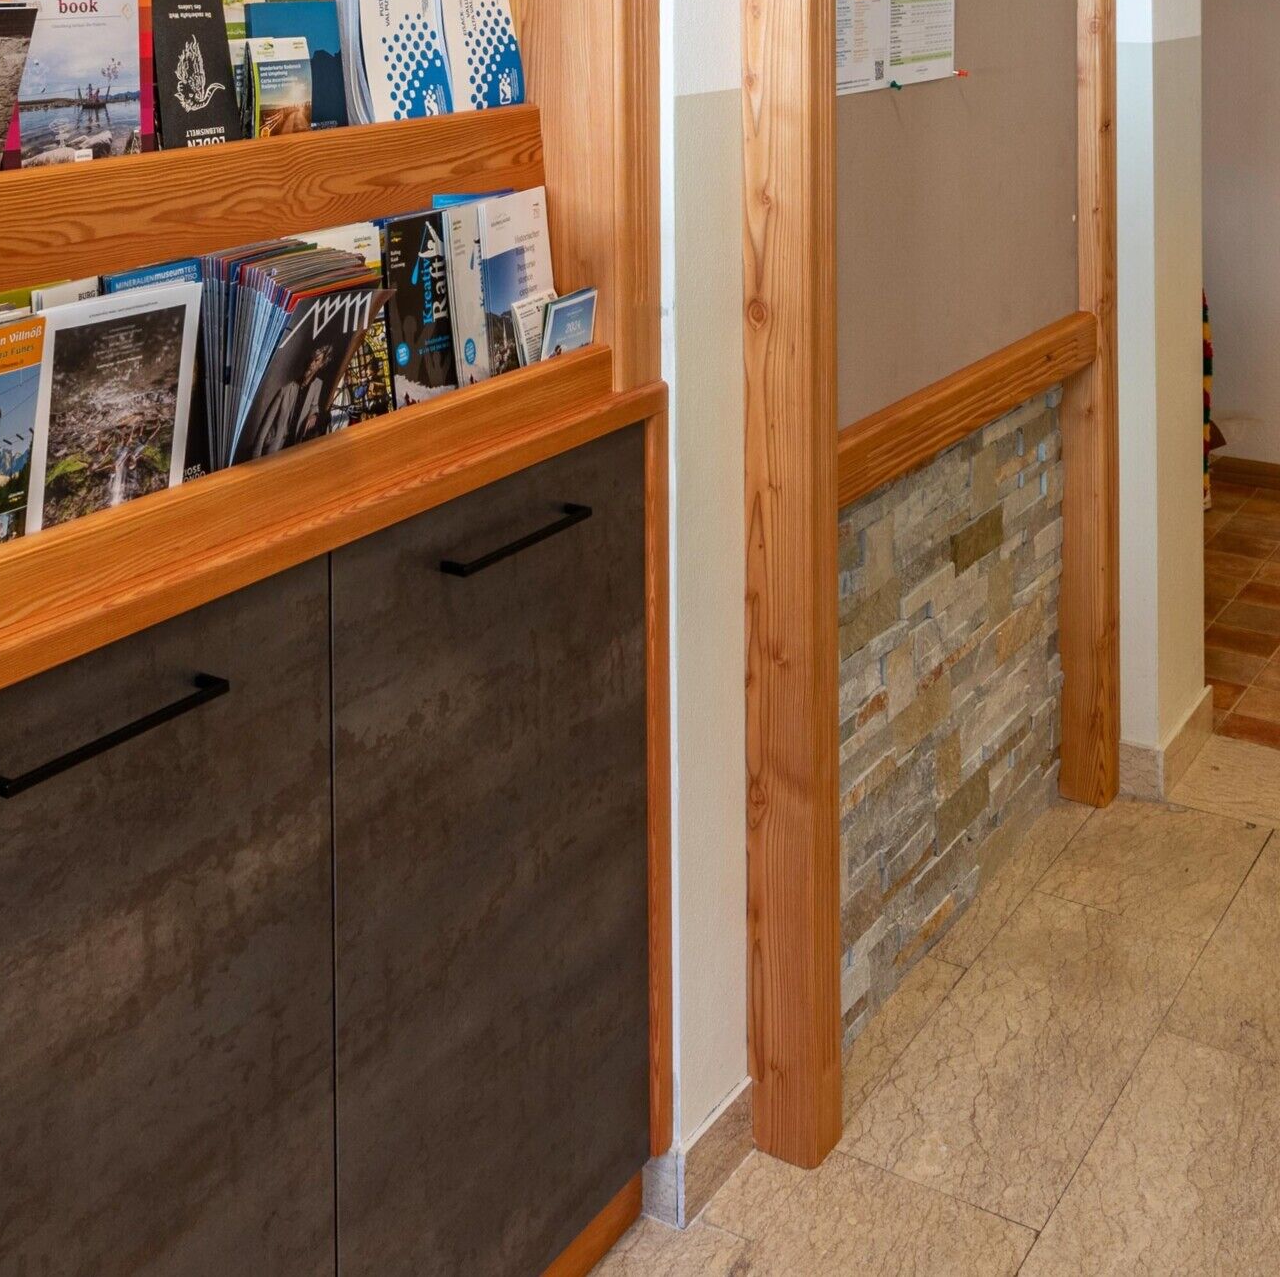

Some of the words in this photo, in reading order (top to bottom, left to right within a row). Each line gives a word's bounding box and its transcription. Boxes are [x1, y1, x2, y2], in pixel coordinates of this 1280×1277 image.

[186, 125, 225, 138] ERLEBNISWELT
[78, 289, 96, 301] BURG
[421, 257, 434, 325] Kreativ
[429, 257, 449, 323] Raft
[9, 325, 42, 344] Villnöß
[11, 345, 34, 356] Funes
